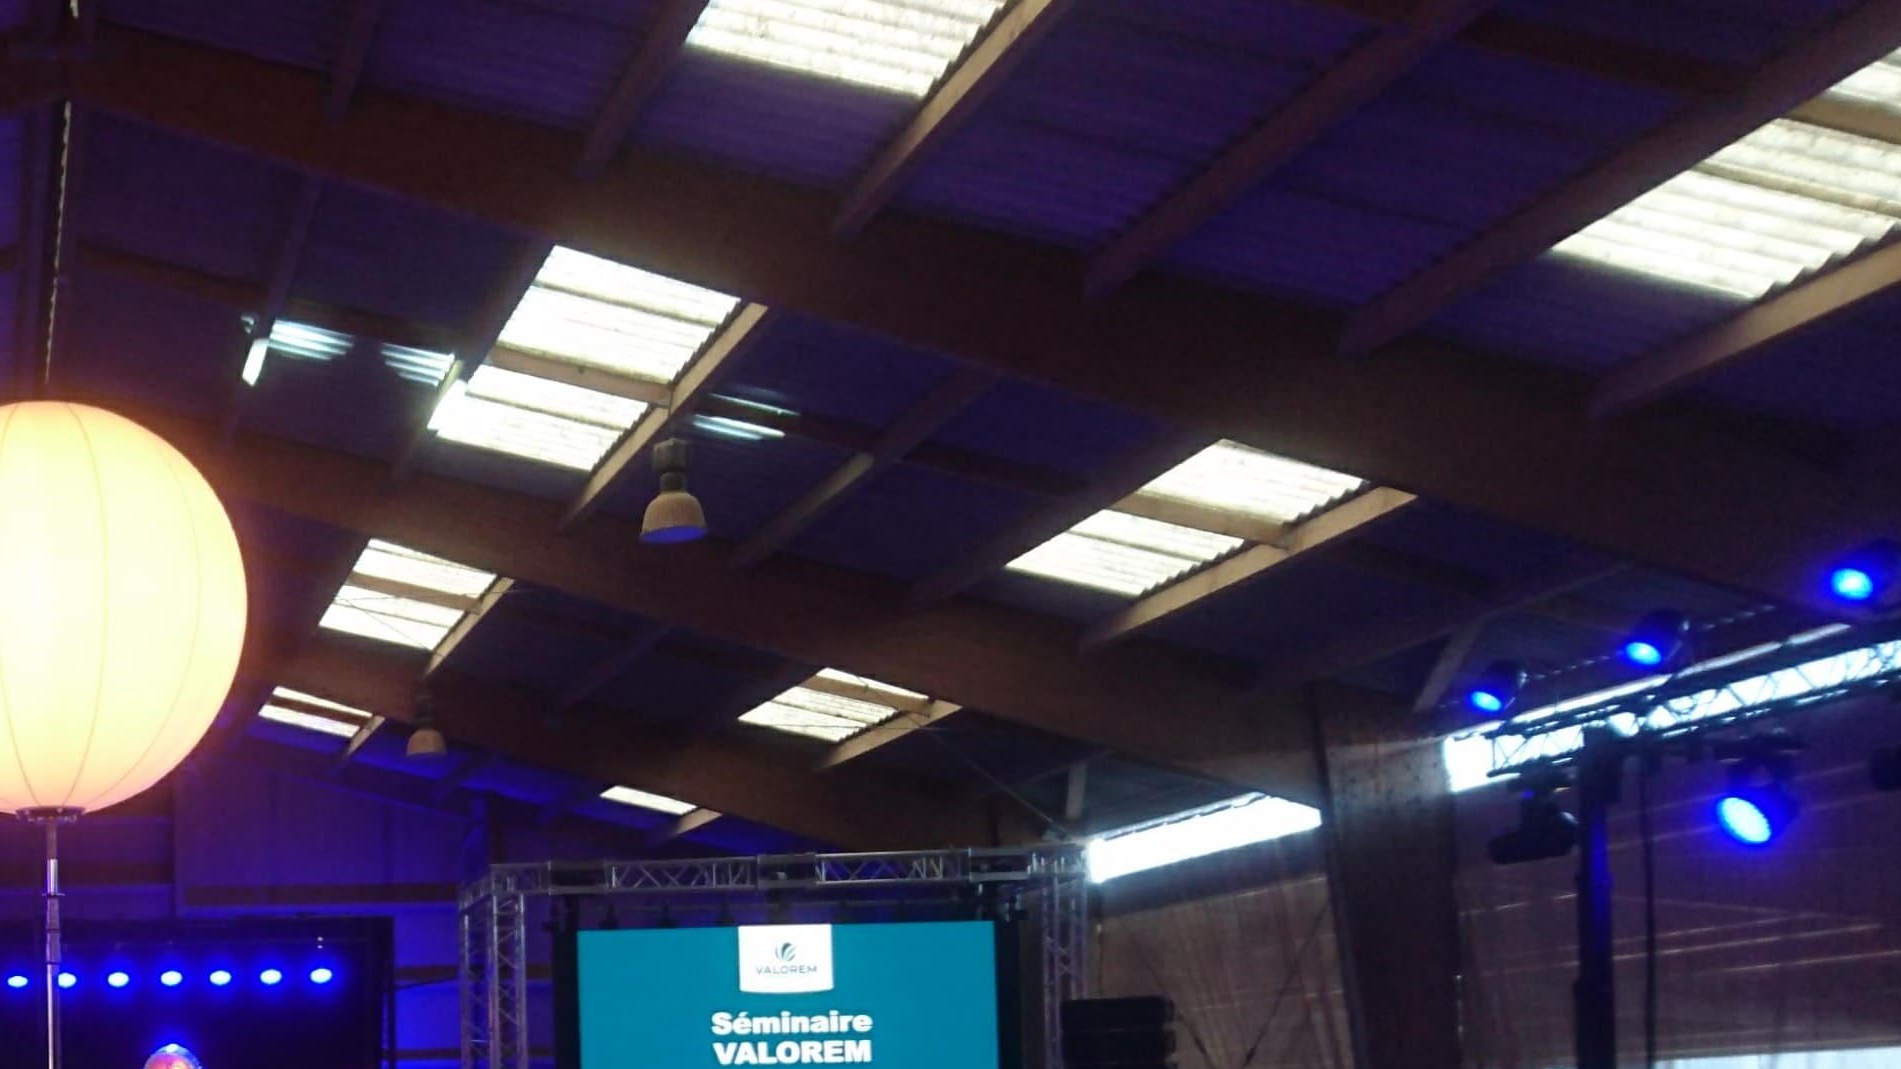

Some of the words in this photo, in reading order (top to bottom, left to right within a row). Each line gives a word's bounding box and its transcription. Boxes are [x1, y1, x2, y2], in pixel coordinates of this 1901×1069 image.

[755, 965, 818, 975] VALOREM
[711, 1009, 873, 1036] Séminaire
[712, 1039, 872, 1066] VALOREM
